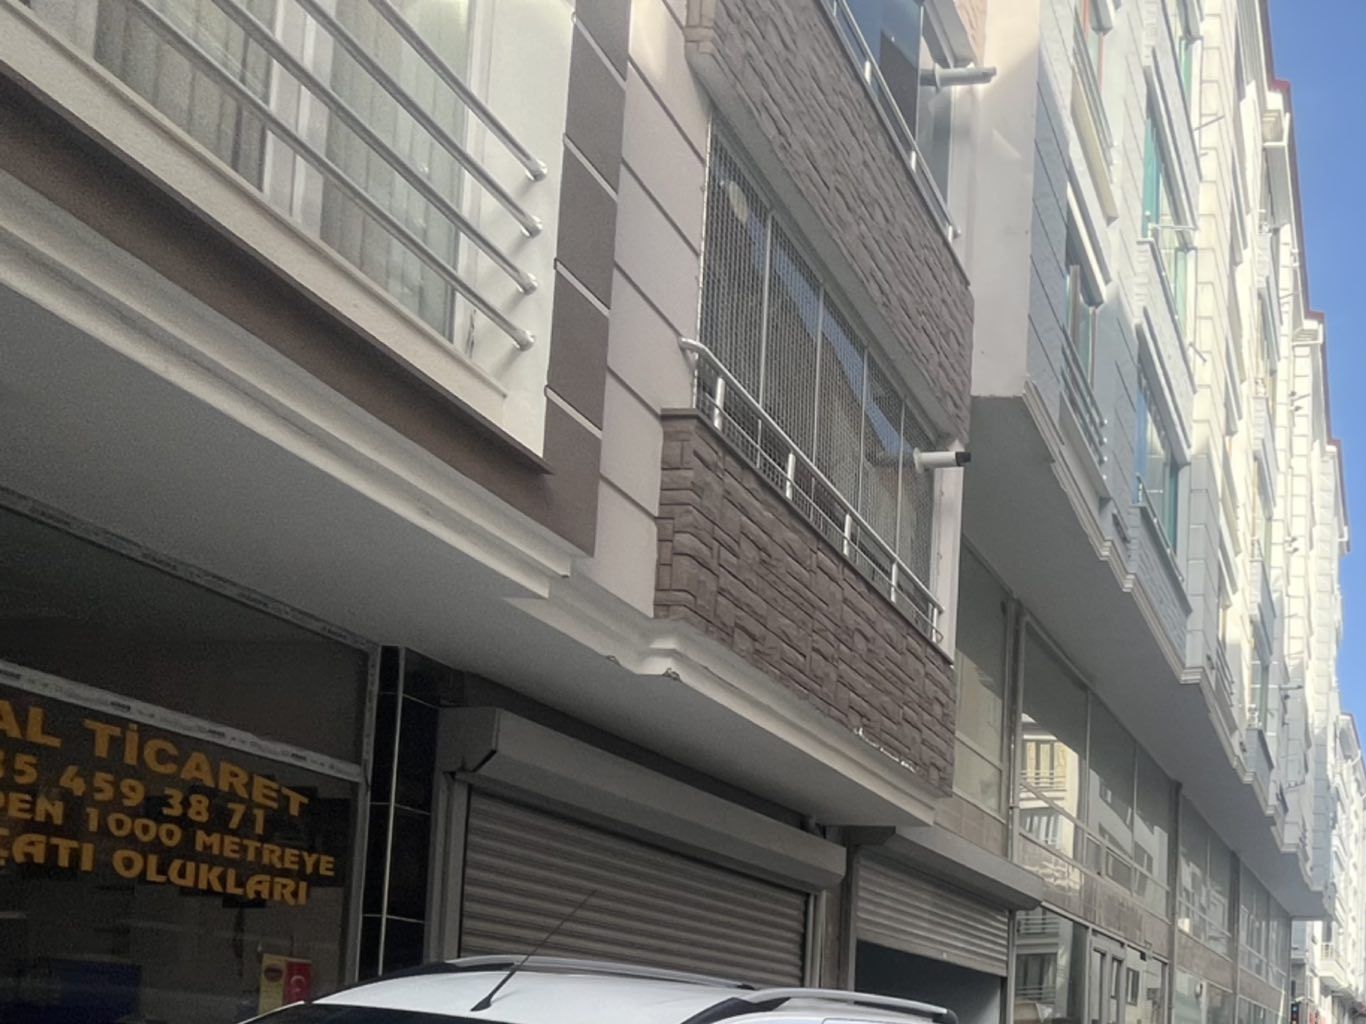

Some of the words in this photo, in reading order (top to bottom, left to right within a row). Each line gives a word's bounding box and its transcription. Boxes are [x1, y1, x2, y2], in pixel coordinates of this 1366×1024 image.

[0, 752, 39, 785] 5
[59, 765, 145, 807] 459
[162, 787, 210, 823] 38
[227, 802, 266, 835] 71
[84, 719, 309, 817] TİCARET
[0, 791, 64, 825] EN
[86, 807, 183, 847] 1000
[195, 830, 335, 876] METREYE
[112, 849, 308, 906] OLUKLARI
